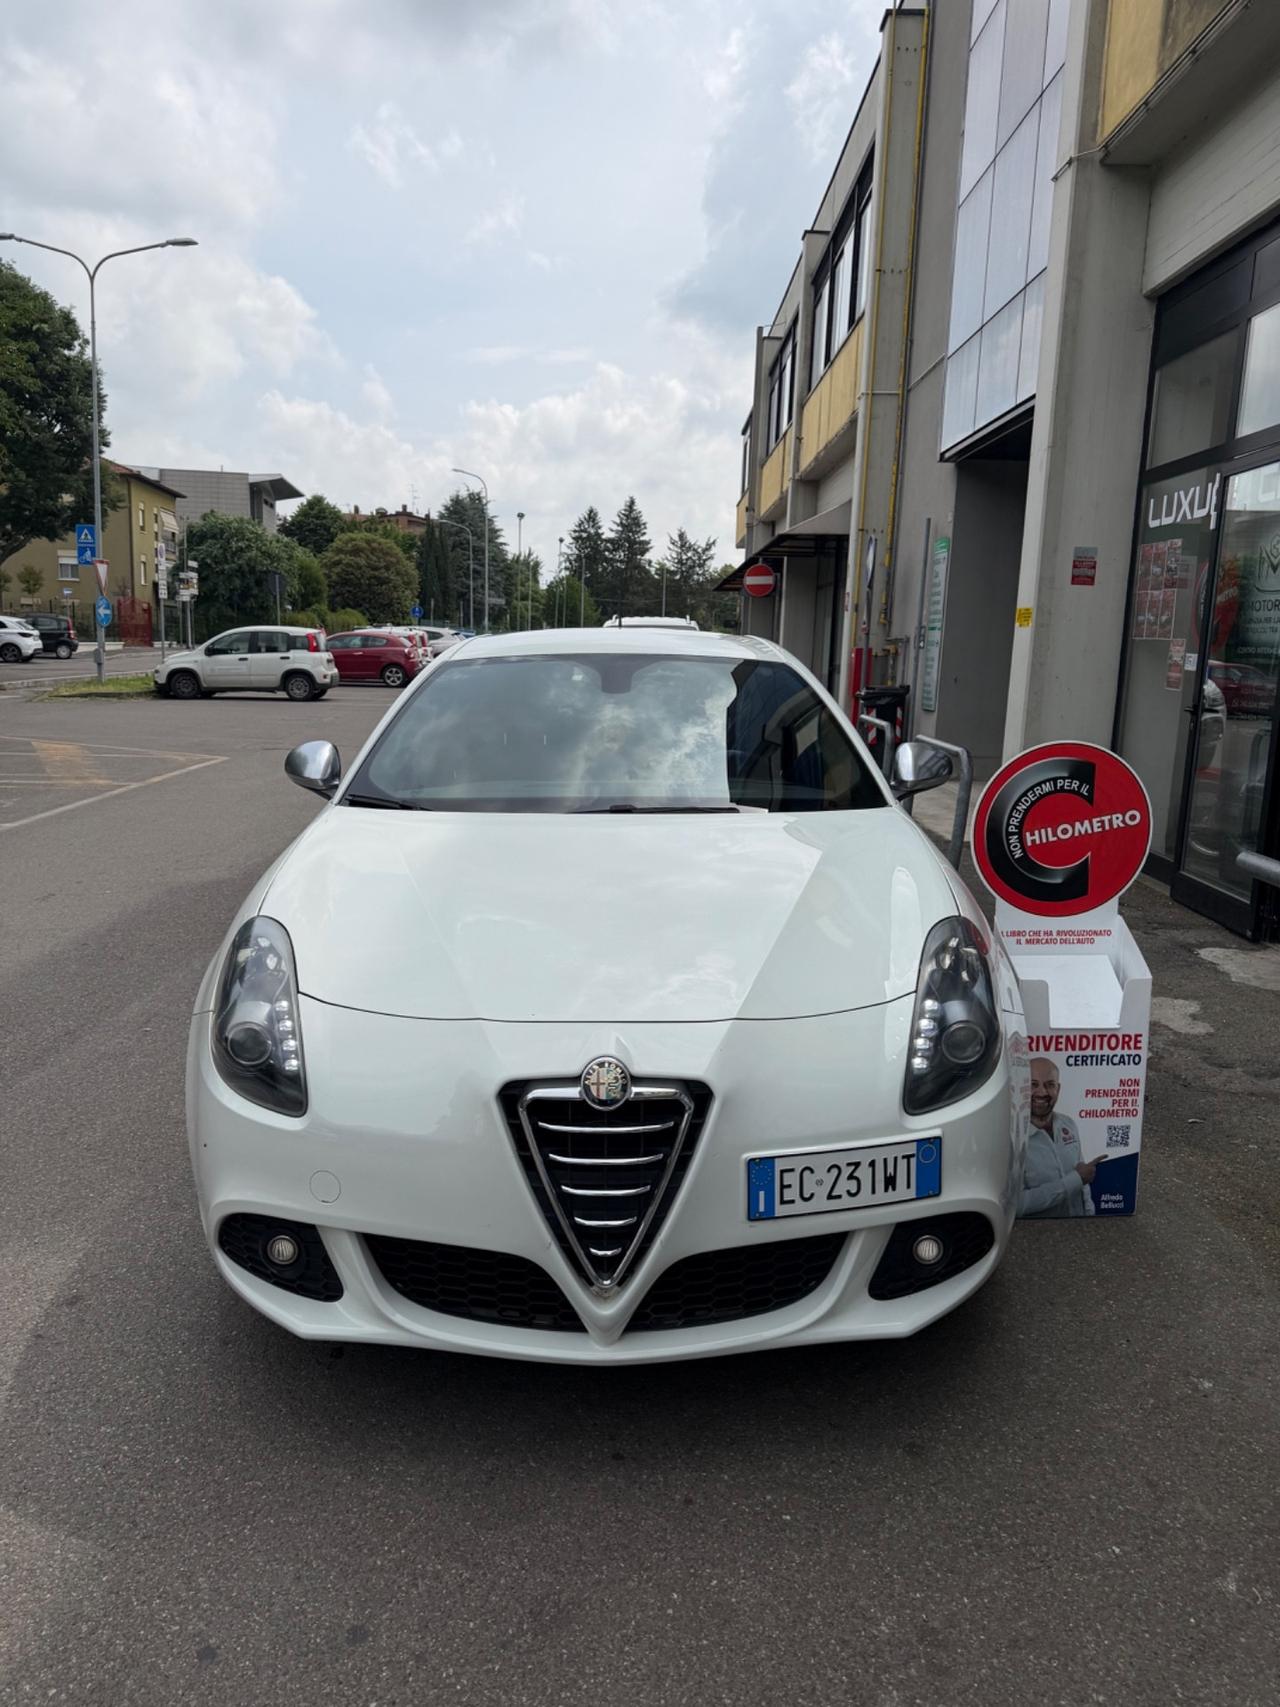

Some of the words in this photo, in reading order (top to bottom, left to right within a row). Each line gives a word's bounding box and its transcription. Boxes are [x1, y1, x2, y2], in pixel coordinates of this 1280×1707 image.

[1148, 474, 1220, 530] LUXU
[1056, 779, 1080, 791] PER
[1080, 783, 1090, 796] IL
[1008, 781, 1055, 833] PRENDERMI
[1025, 809, 1142, 847] HILOMETRO
[1008, 836, 1024, 859] NON
[1006, 930, 1027, 938] LIBRO
[1028, 930, 1042, 938] CHE
[1043, 930, 1054, 938] HA
[1056, 929, 1112, 937] RIVOLUZIONATO
[1027, 1034, 1143, 1052] RIVENDITORE
[1066, 1054, 1142, 1067] CERTIFICATO
[1119, 1078, 1140, 1087] NON
[1085, 1088, 1139, 1098] PRENDERMI
[1112, 1099, 1129, 1107] PER
[1079, 1108, 1138, 1118] CHILOMETRO
[779, 1166, 815, 1205] EC
[826, 1153, 916, 1200] 231WT
